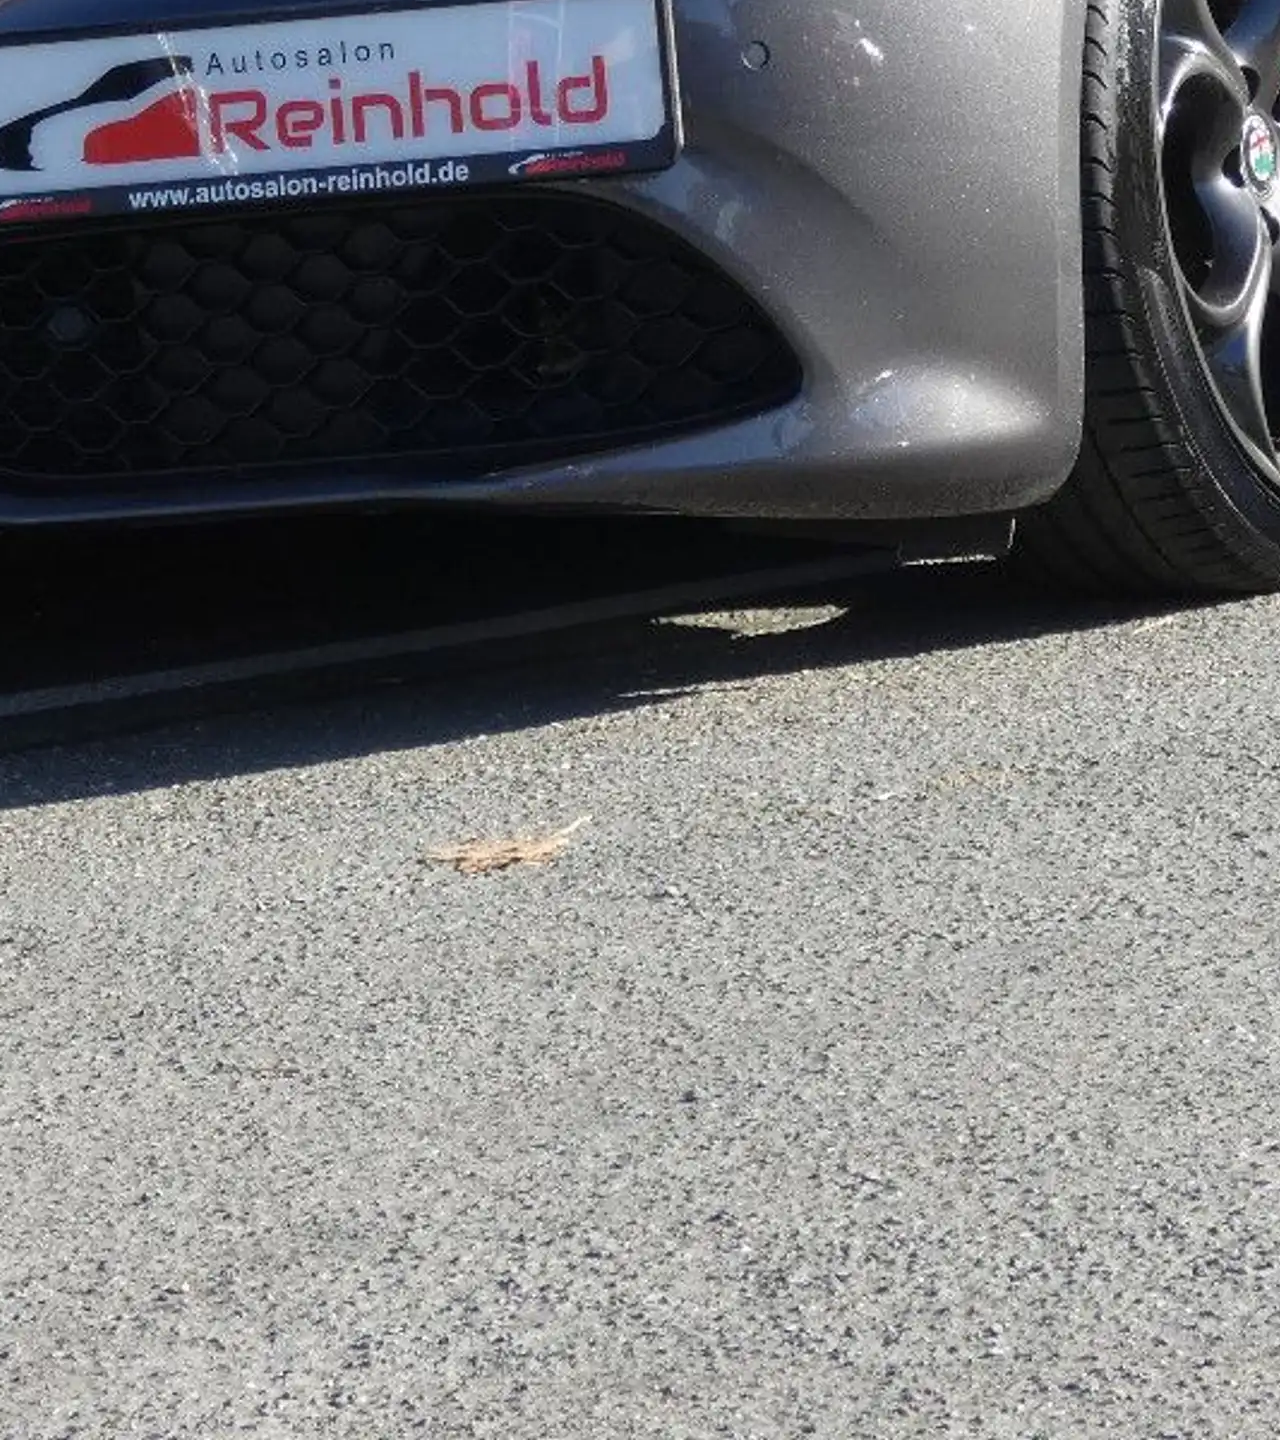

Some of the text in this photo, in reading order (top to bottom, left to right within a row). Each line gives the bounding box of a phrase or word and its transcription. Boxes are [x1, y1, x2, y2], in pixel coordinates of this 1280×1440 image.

[205, 39, 396, 76] Autosalon
[208, 55, 610, 155] Reinhold
[128, 161, 469, 210] www.autosalon-reinhold.de
